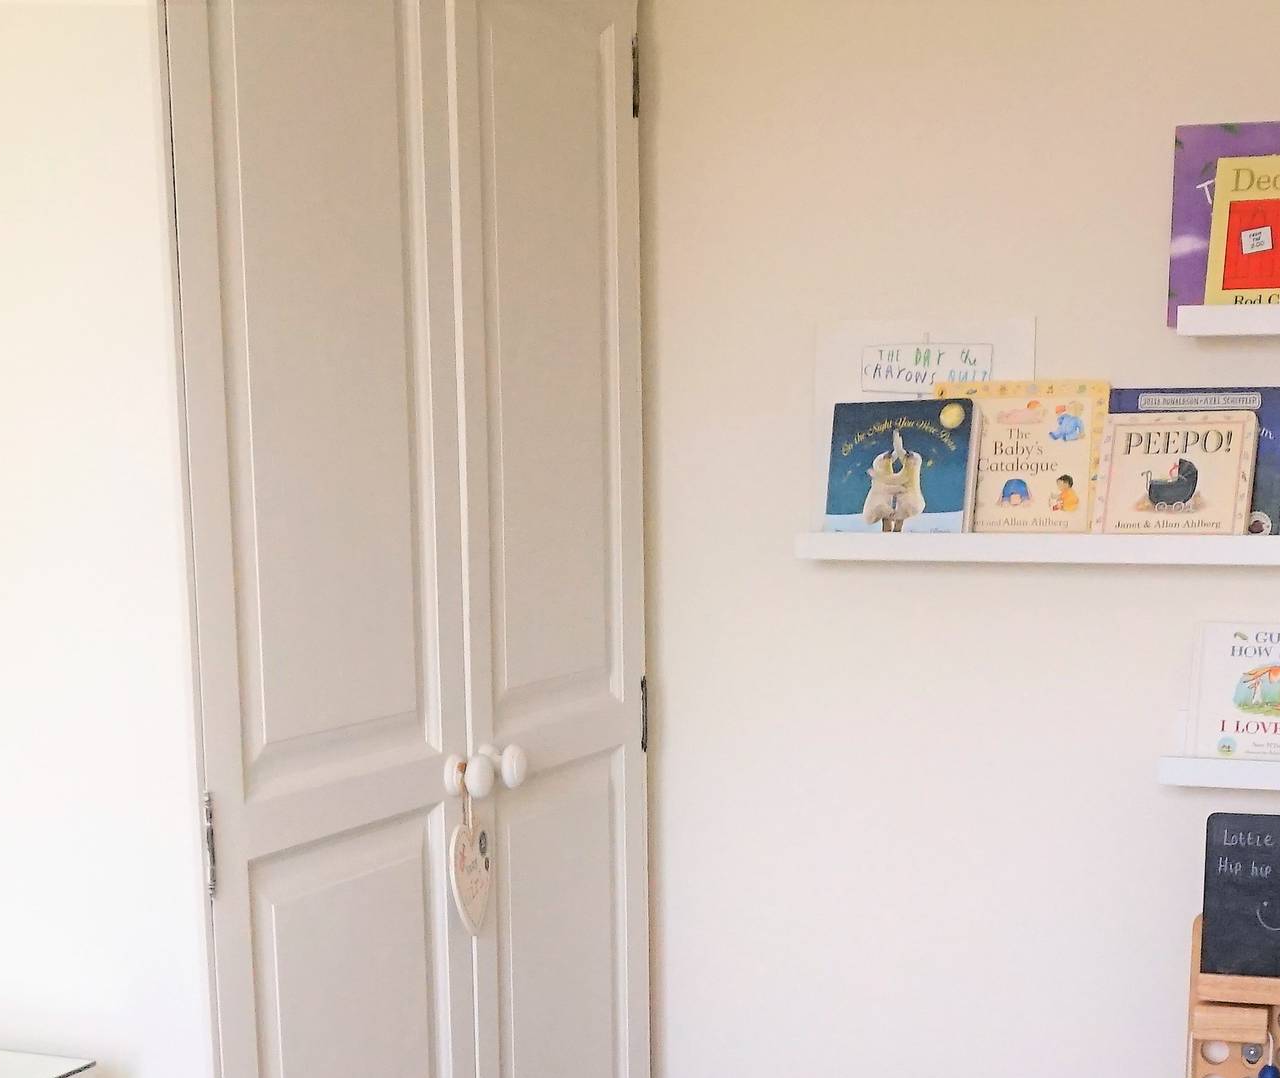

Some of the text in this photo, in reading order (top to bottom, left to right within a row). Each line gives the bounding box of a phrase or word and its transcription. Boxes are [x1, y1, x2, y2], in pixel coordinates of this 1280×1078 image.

[914, 347, 946, 367] DAY
[1009, 427, 1031, 440] The
[993, 440, 1044, 458] Baby's
[1124, 430, 1233, 455] PEEPO!
[978, 458, 1059, 475] Catalogue
[1144, 521, 1152, 529] &
[1153, 519, 1181, 529] Allan
[1183, 519, 1221, 530] Ahlberg
[1230, 645, 1273, 658] HOW
[1220, 720, 1227, 732] I
[1223, 828, 1274, 847] Lottie
[1218, 857, 1242, 874] Hip
[1250, 860, 1273, 878] hip
